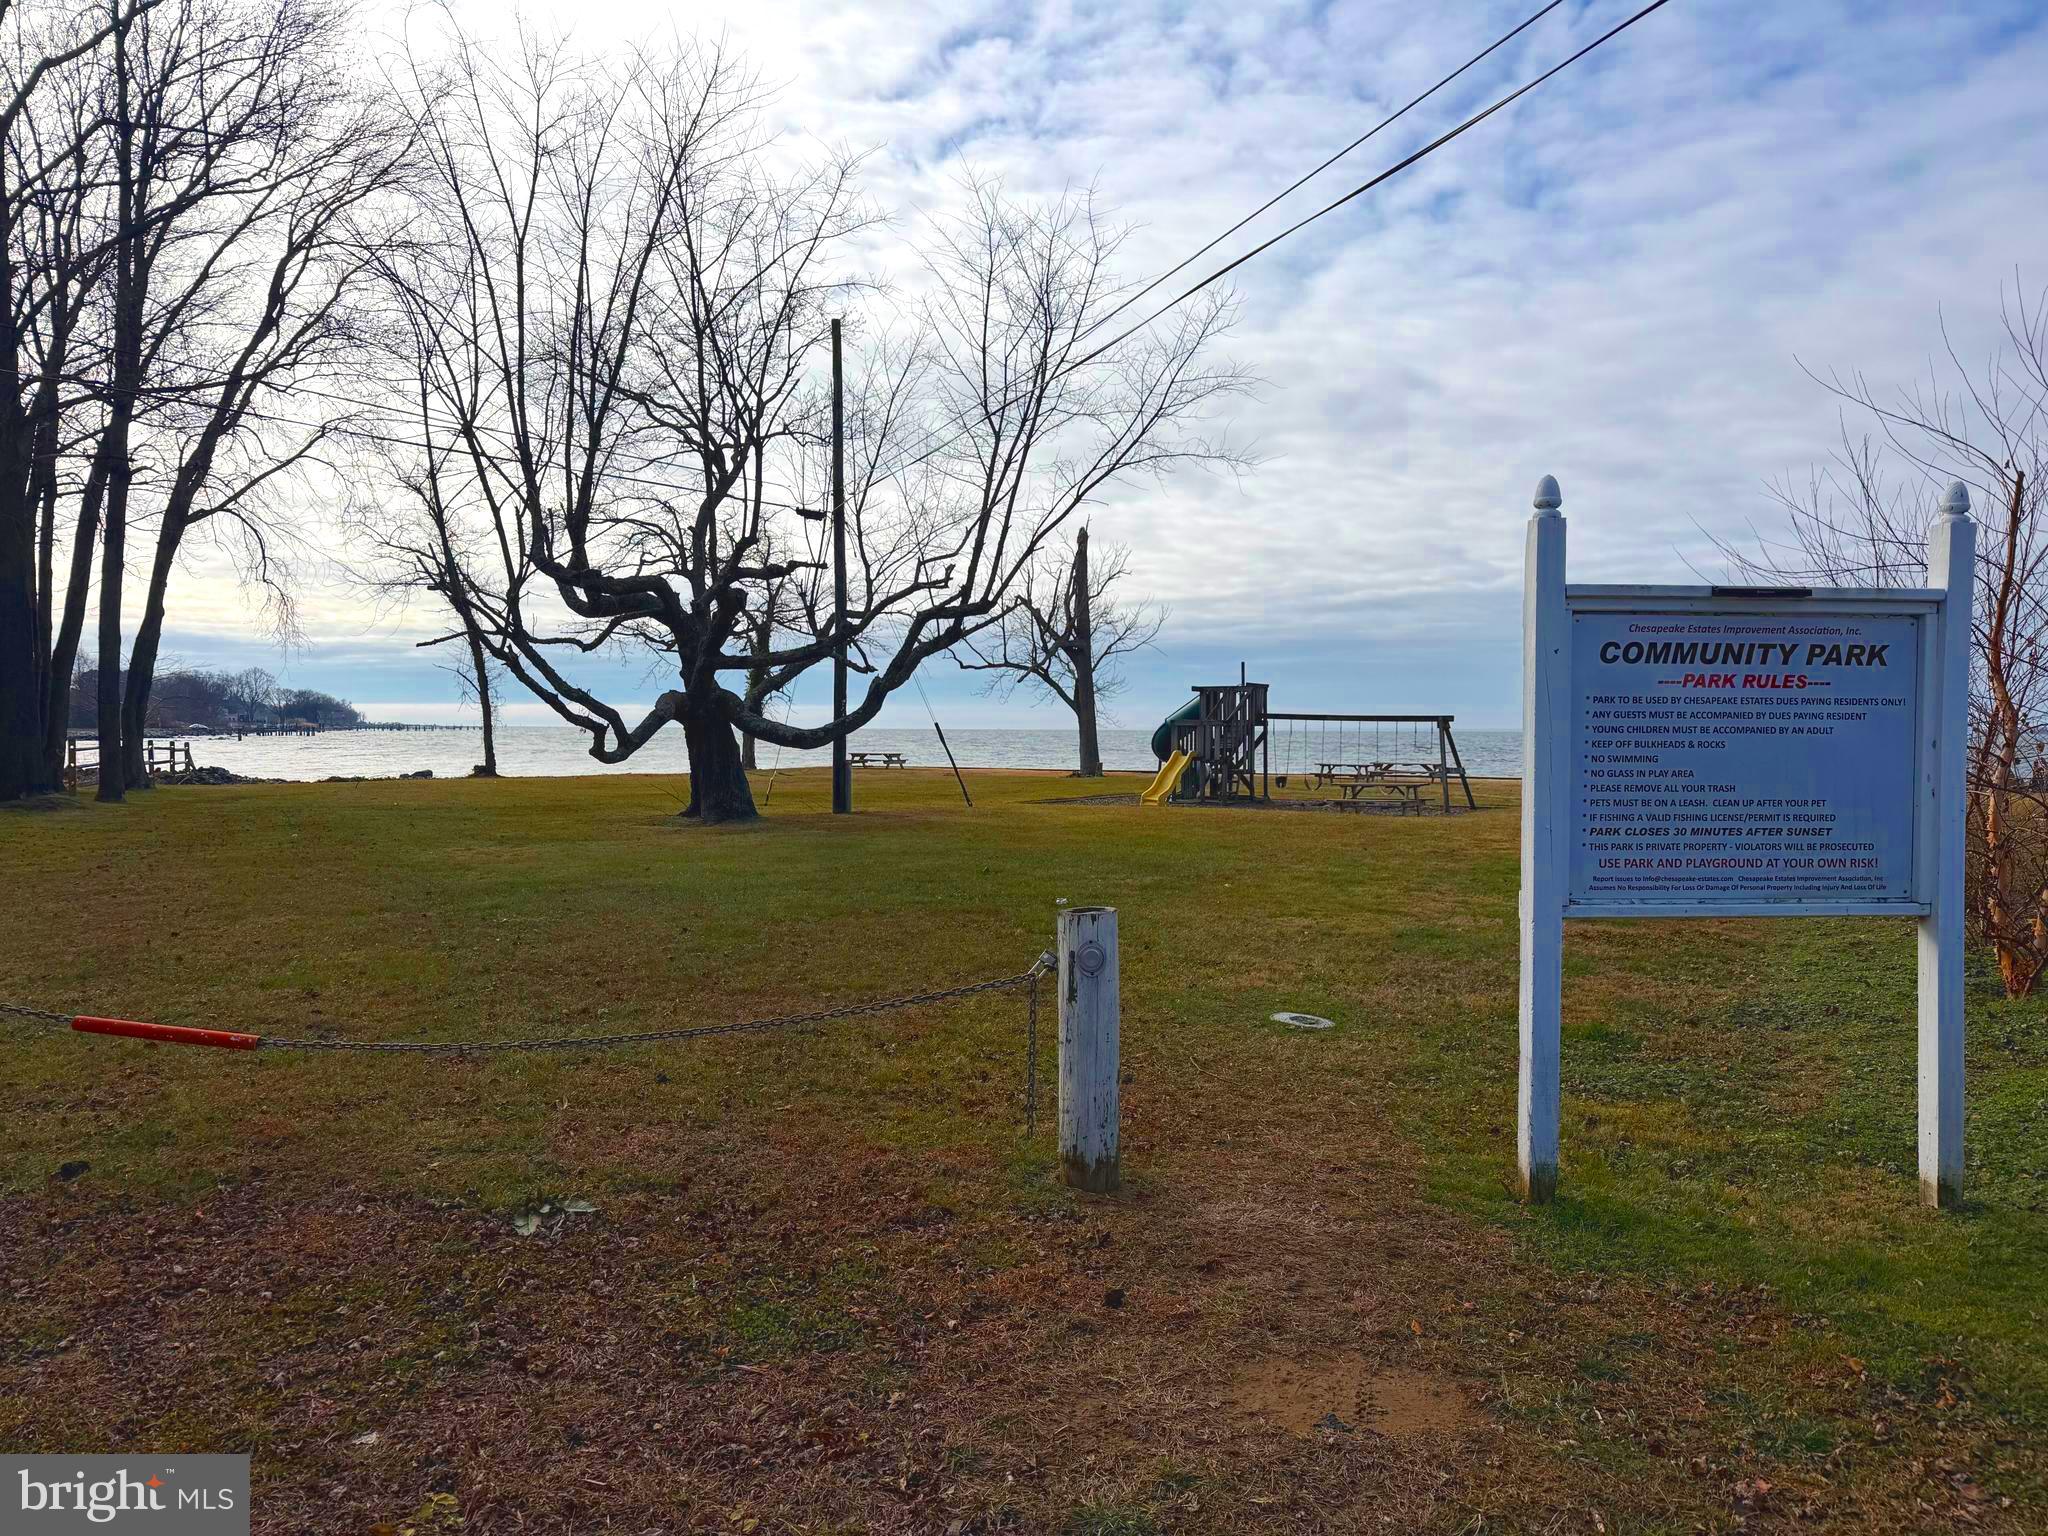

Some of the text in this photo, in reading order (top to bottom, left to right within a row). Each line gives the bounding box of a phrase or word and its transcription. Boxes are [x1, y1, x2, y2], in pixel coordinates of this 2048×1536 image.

[1629, 624, 1861, 636] Chesapeake Estates Improvement Association, Inc.
[1600, 642, 1889, 666] COMMUNITY PARK
[1593, 696, 1616, 704] PARK
[1618, 696, 1630, 704] TO
[1633, 696, 1643, 704] BE
[1646, 696, 1668, 704] USED
[1684, 697, 1738, 705] CHESAPEAKE
[1741, 697, 1773, 705] ESTATES
[1777, 697, 1798, 705] DUES
[1834, 698, 1879, 706] RESIDENTS
[1614, 711, 1646, 719] GUESTS
[1649, 711, 1674, 719] MUST
[1769, 712, 1791, 720] DUES
[1672, 726, 1698, 734] MUST
[1700, 726, 1710, 734] BE
[1713, 726, 1776, 734] ACCOMPANIED
[1591, 755, 1659, 763] NO SWIMMING
[1671, 770, 1694, 778] AREA
[1590, 799, 1610, 807] PETS
[1613, 799, 1639, 807] MUST
[1642, 799, 1652, 807] BE
[1655, 799, 1668, 807] ON
[1600, 814, 1634, 822] FISHING
[1646, 814, 1671, 822] VALID
[1674, 814, 1708, 822] FISHING
[1711, 814, 1781, 823] LICENSE/PERMIT
[1793, 814, 1836, 822] REQUIRED
[1590, 828, 1832, 836] PARK CLOSES 30 MINUTES AFTER SUNSET
[1611, 843, 1633, 851] PARK
[1636, 843, 1643, 851] IS
[1646, 843, 1680, 851] PRIVATE
[1684, 843, 1728, 851] PROPERTY
[1735, 843, 1782, 851] VIOLATORS
[1820, 843, 1874, 851] PROSECUTED
[1599, 859, 1878, 869] USE PARK AND PLAYGROUND AT YOUR OWN RISK!
